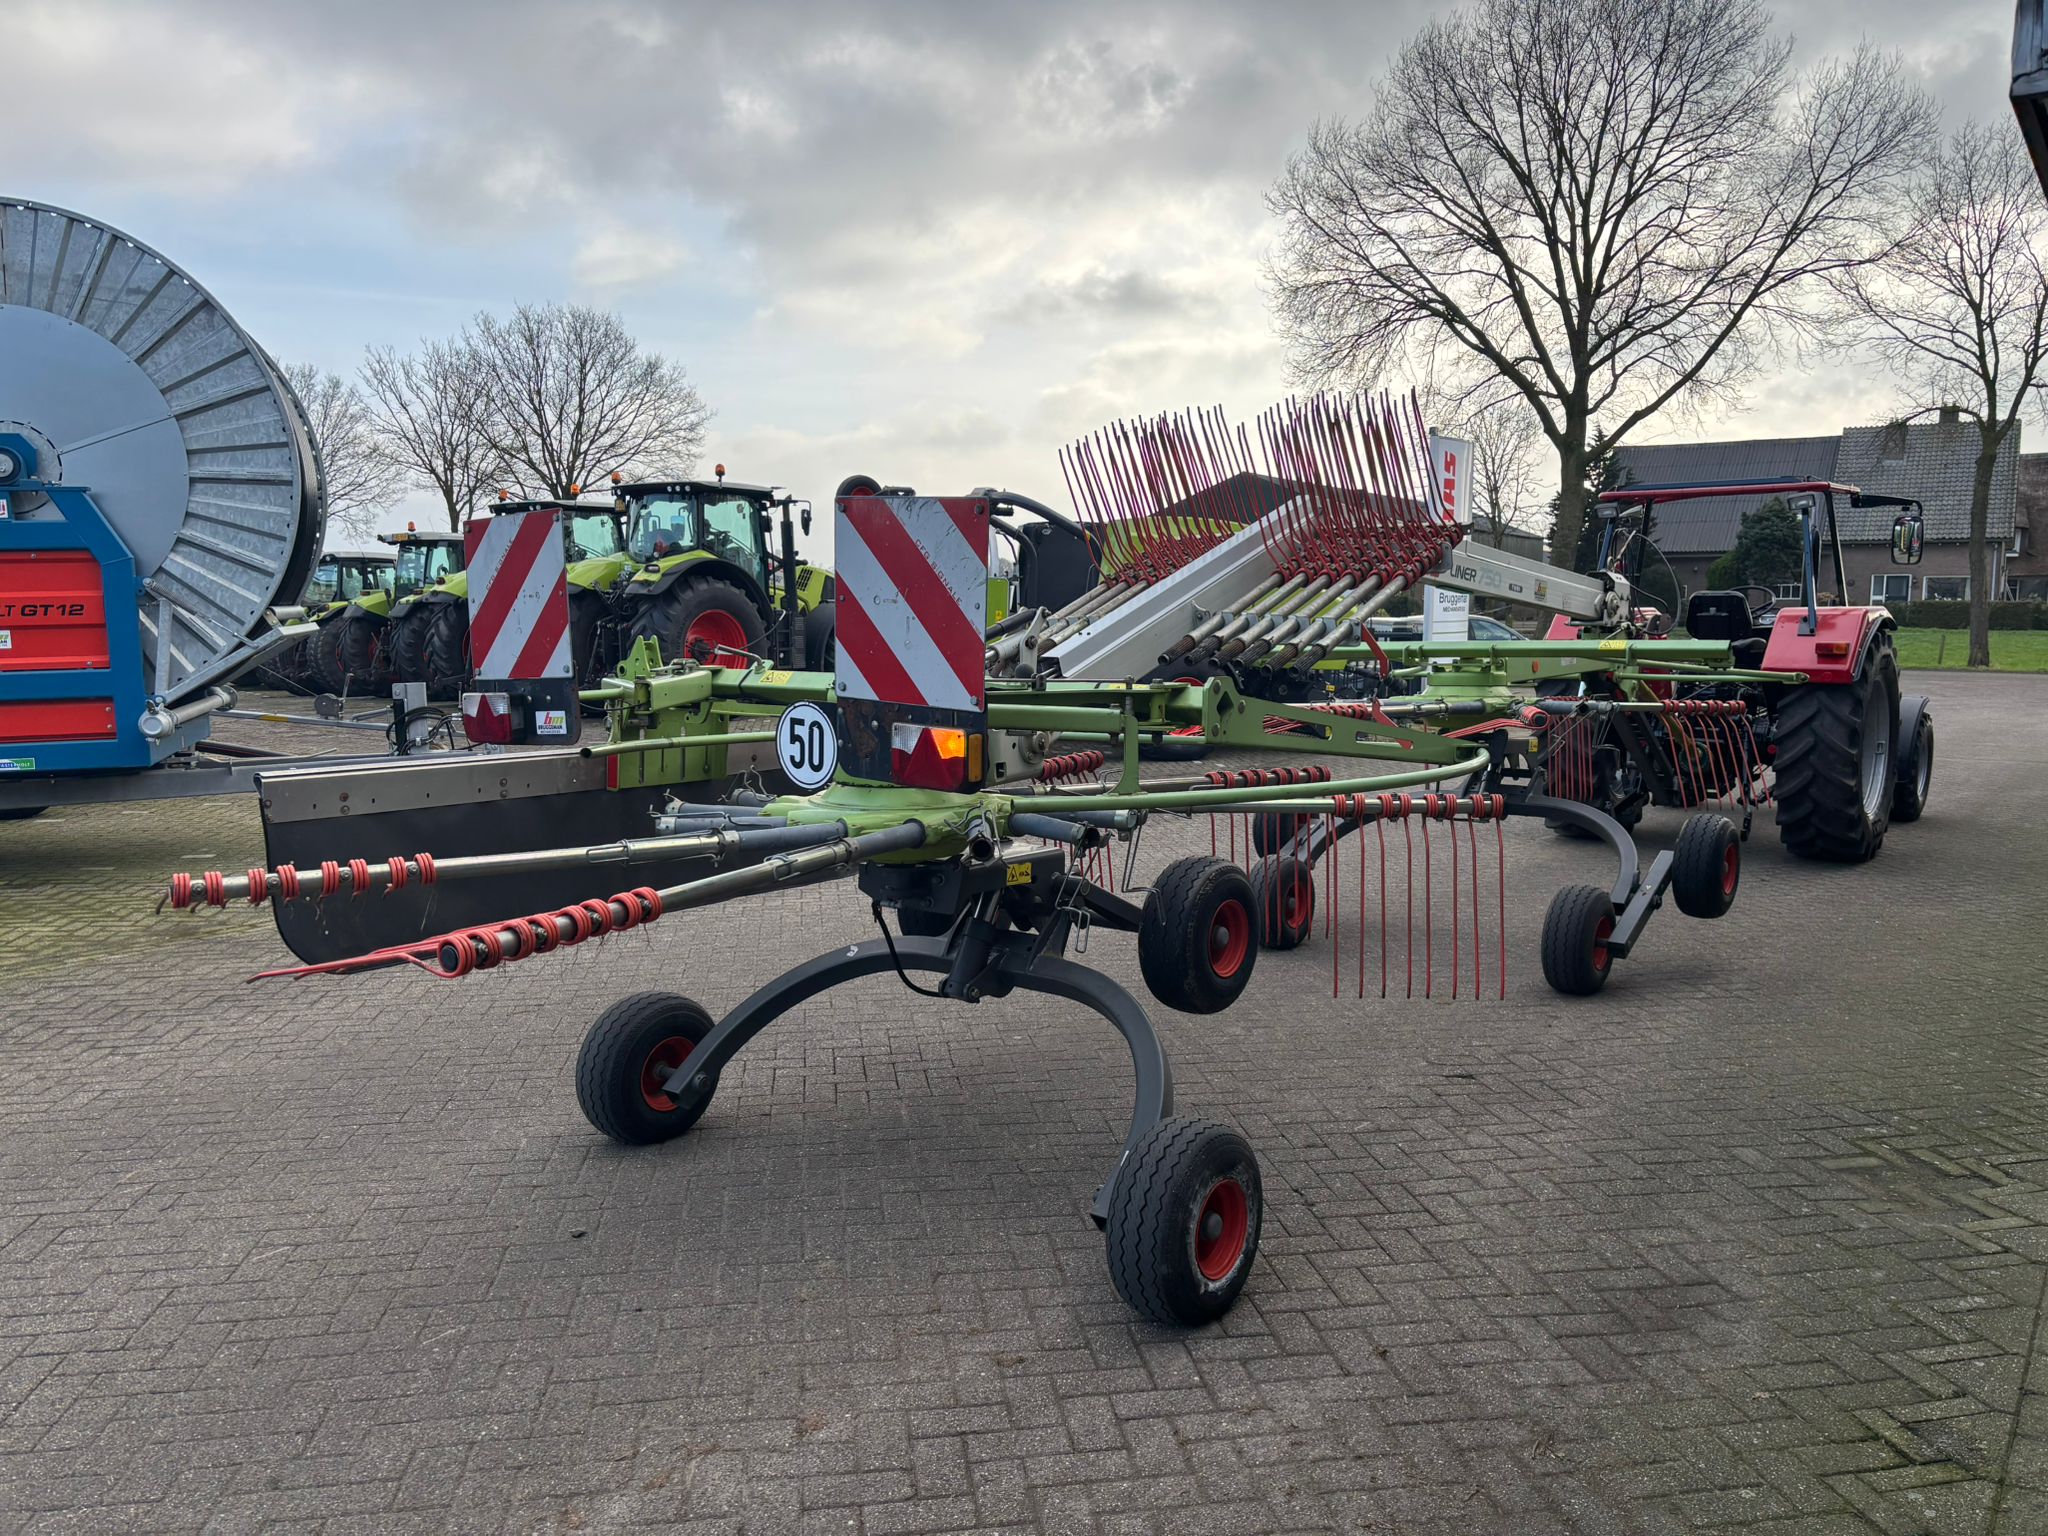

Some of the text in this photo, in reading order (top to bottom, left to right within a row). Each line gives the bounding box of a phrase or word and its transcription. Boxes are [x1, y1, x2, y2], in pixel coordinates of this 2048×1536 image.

[931, 562, 963, 606] SIGNALE
[1479, 567, 1503, 587] 750
[789, 716, 825, 773] 50
